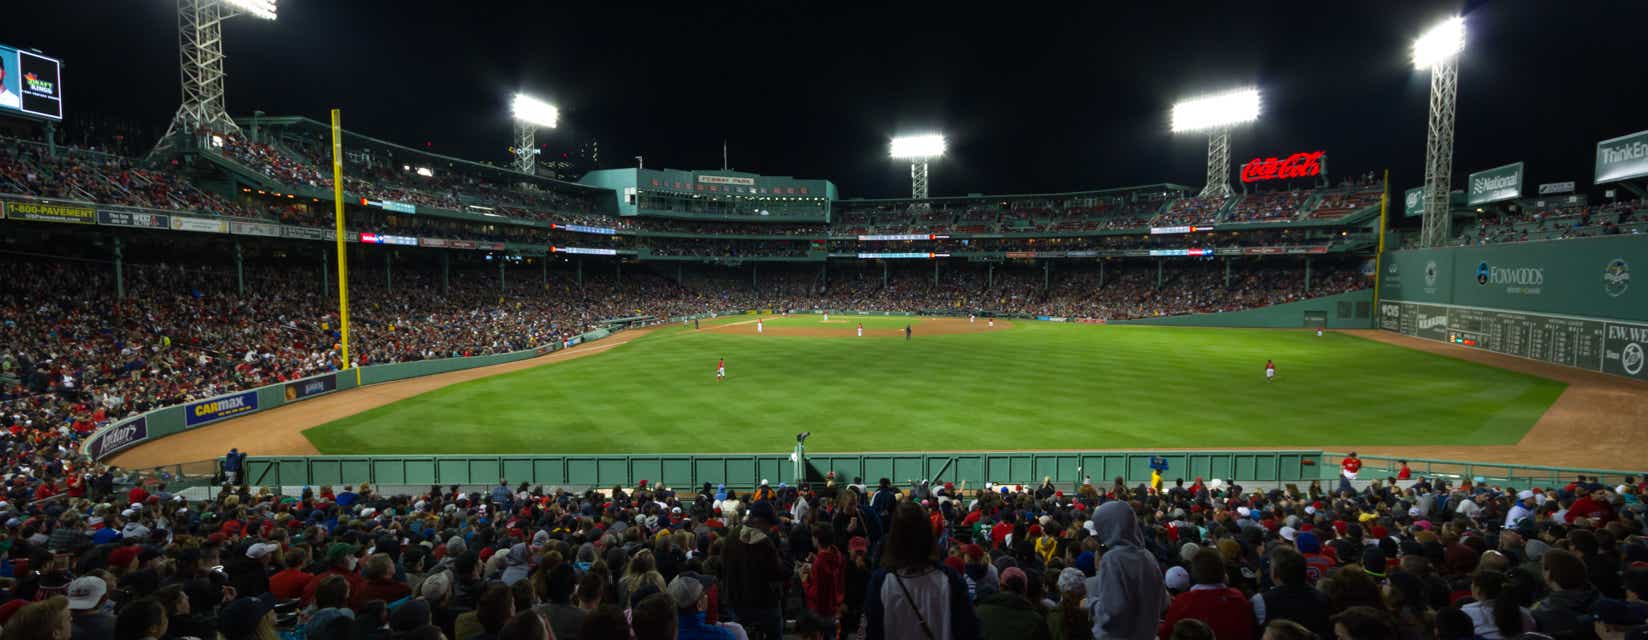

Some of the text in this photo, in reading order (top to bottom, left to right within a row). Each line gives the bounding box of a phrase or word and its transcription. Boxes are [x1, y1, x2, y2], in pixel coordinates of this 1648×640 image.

[1241, 150, 1326, 183] Coca-Cola
[1482, 171, 1518, 191] National
[9, 204, 93, 217] 1-800-PAVEMENT
